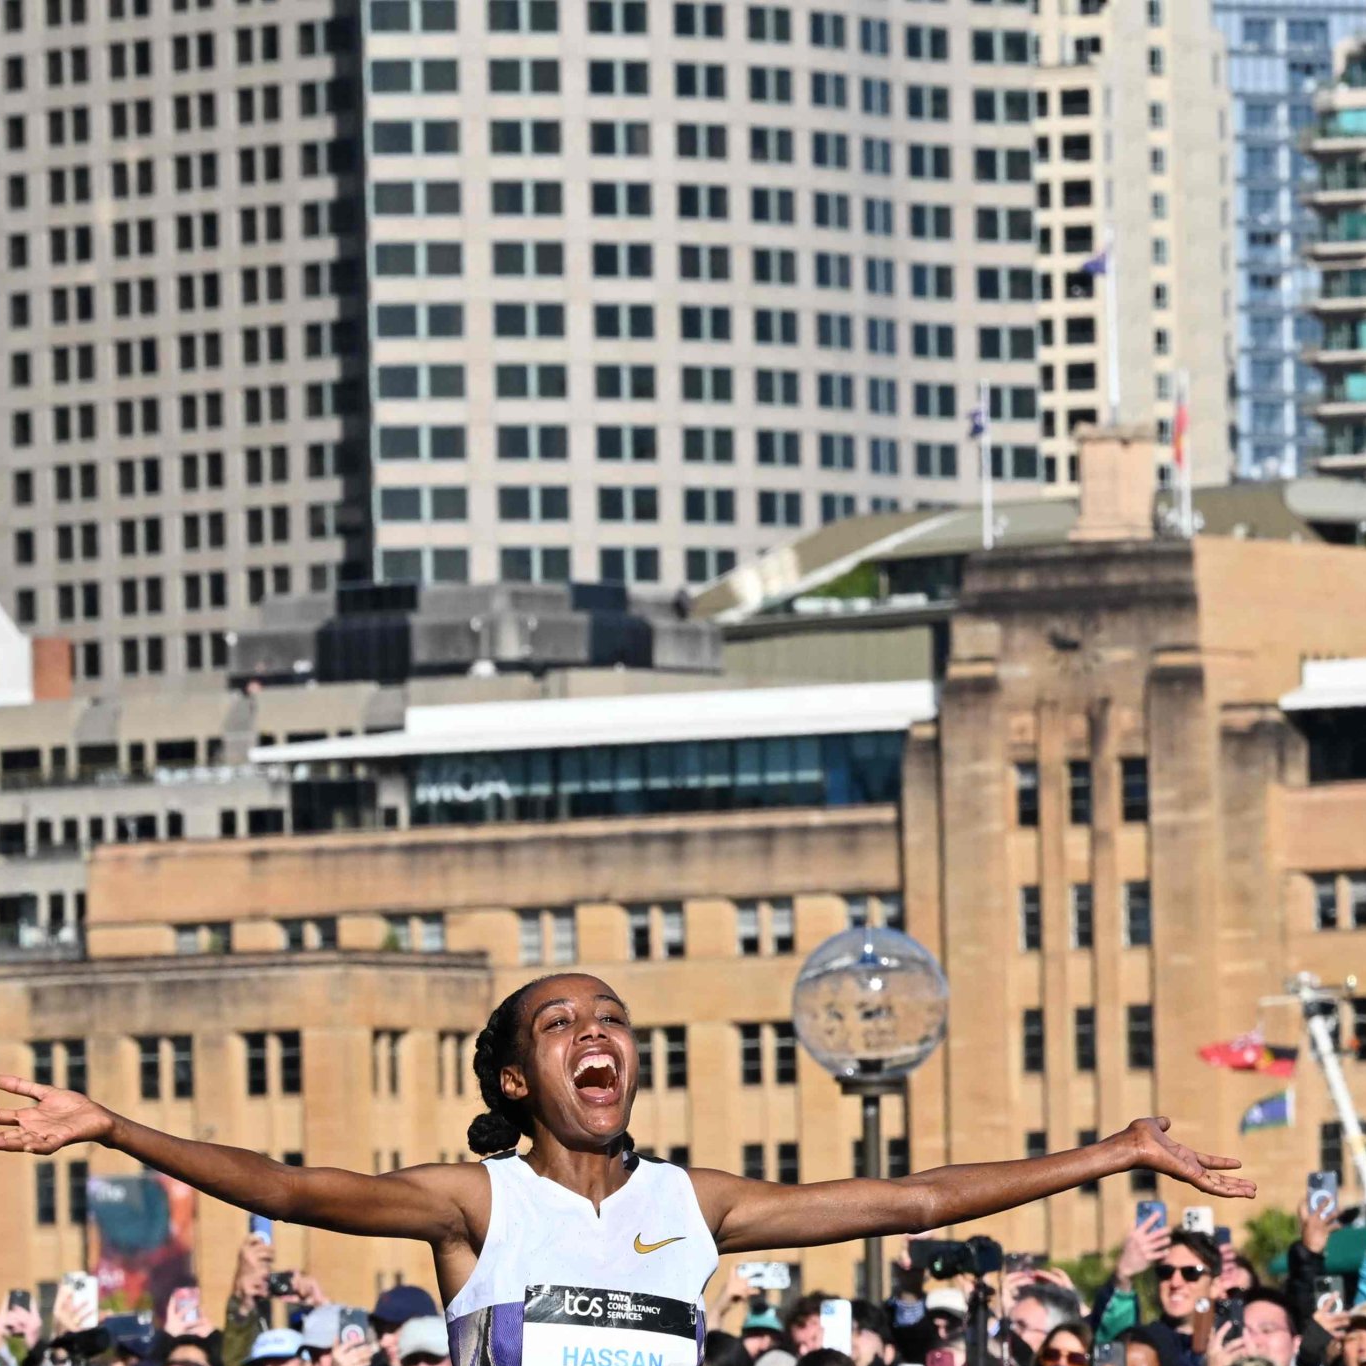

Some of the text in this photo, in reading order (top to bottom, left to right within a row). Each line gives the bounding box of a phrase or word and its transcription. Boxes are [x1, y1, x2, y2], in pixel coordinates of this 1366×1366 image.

[607, 1293, 631, 1303] TATA
[607, 1301, 661, 1316] CONSULTANCY
[607, 1311, 643, 1321] SERVICES
